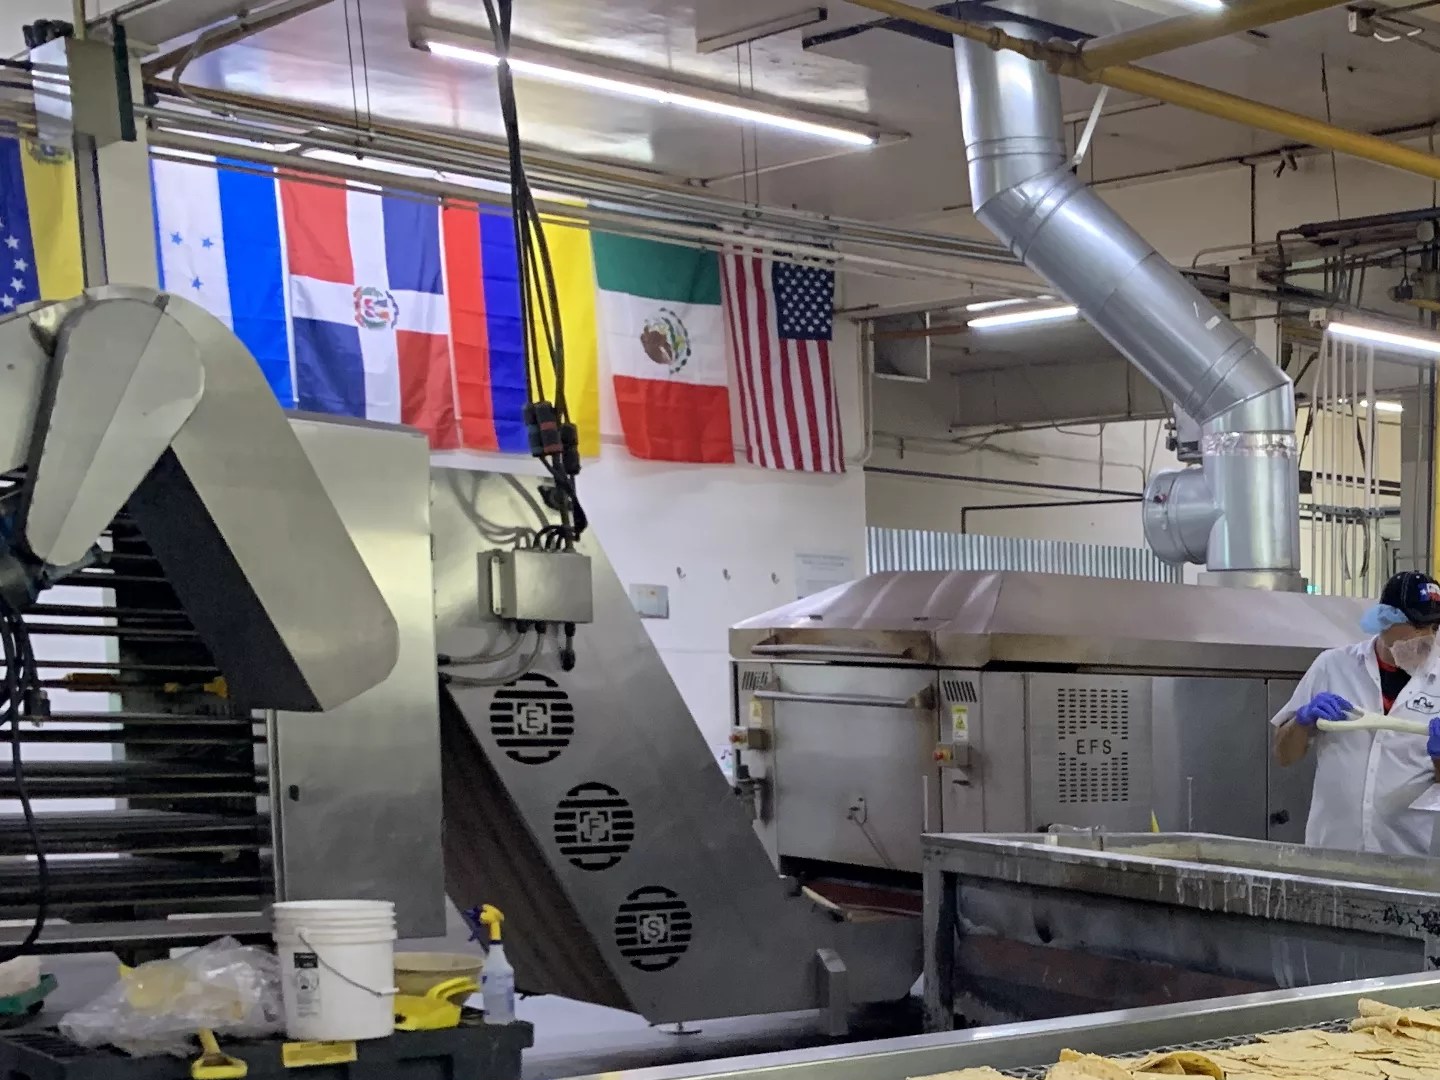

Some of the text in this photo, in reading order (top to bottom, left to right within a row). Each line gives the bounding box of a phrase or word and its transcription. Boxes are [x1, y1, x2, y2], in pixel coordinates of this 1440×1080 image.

[526, 709, 539, 729] E
[1077, 739, 1111, 755] EFS
[588, 817, 600, 836] F
[648, 920, 661, 938] S
